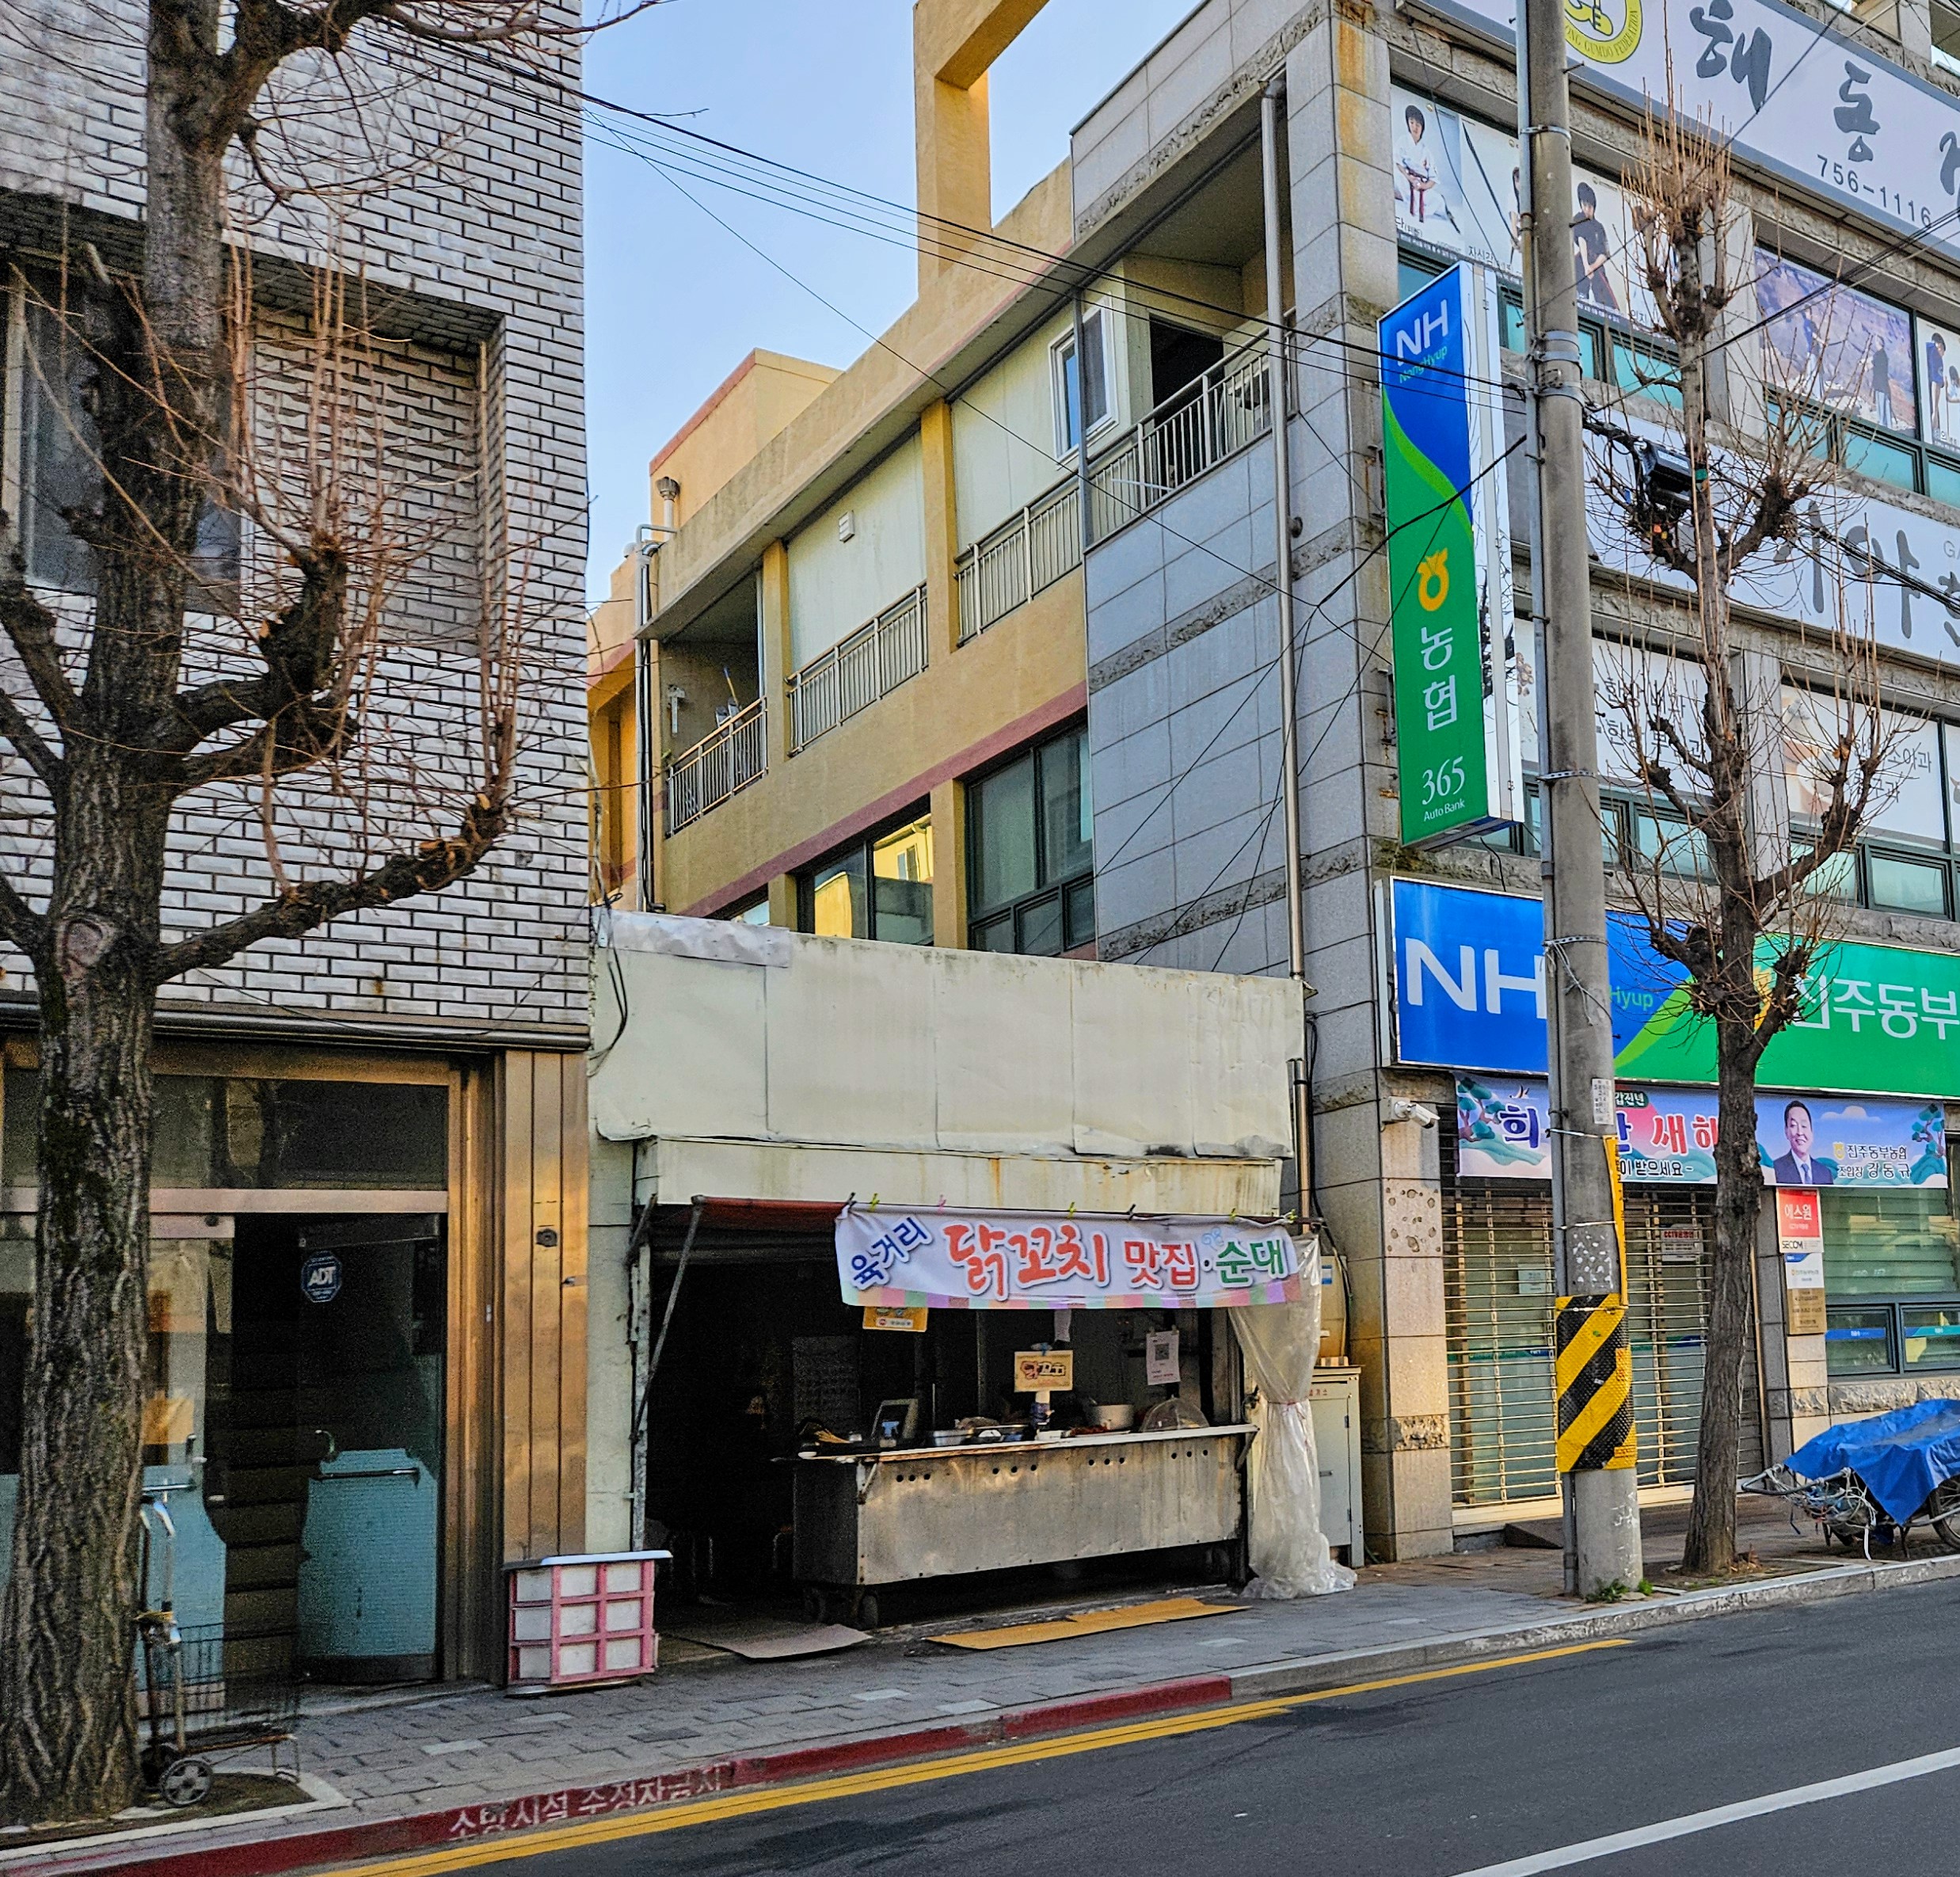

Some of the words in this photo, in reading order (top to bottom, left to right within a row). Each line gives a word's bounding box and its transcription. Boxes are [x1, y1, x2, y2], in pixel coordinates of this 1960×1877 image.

[1817, 154, 1931, 228] 756-1116
[1396, 299, 1448, 367] NH
[1421, 626, 1457, 732] 농협
[1421, 755, 1465, 805] 365
[1423, 808, 1444, 822] Auto
[1444, 798, 1465, 815] Bank
[1405, 937, 1547, 1020] NH
[1608, 984, 1654, 1011] Hyup
[1615, 1091, 1645, 1106] 갑진년
[1847, 1144, 1907, 1160] 진주동부농협
[1635, 1160, 1684, 1176] 받으세요
[1784, 1204, 1813, 1220] 에스원
[1782, 1240, 1803, 1249] SECOM
[943, 1224, 1107, 1296] 닭꼬치
[307, 1266, 337, 1287] ADT
